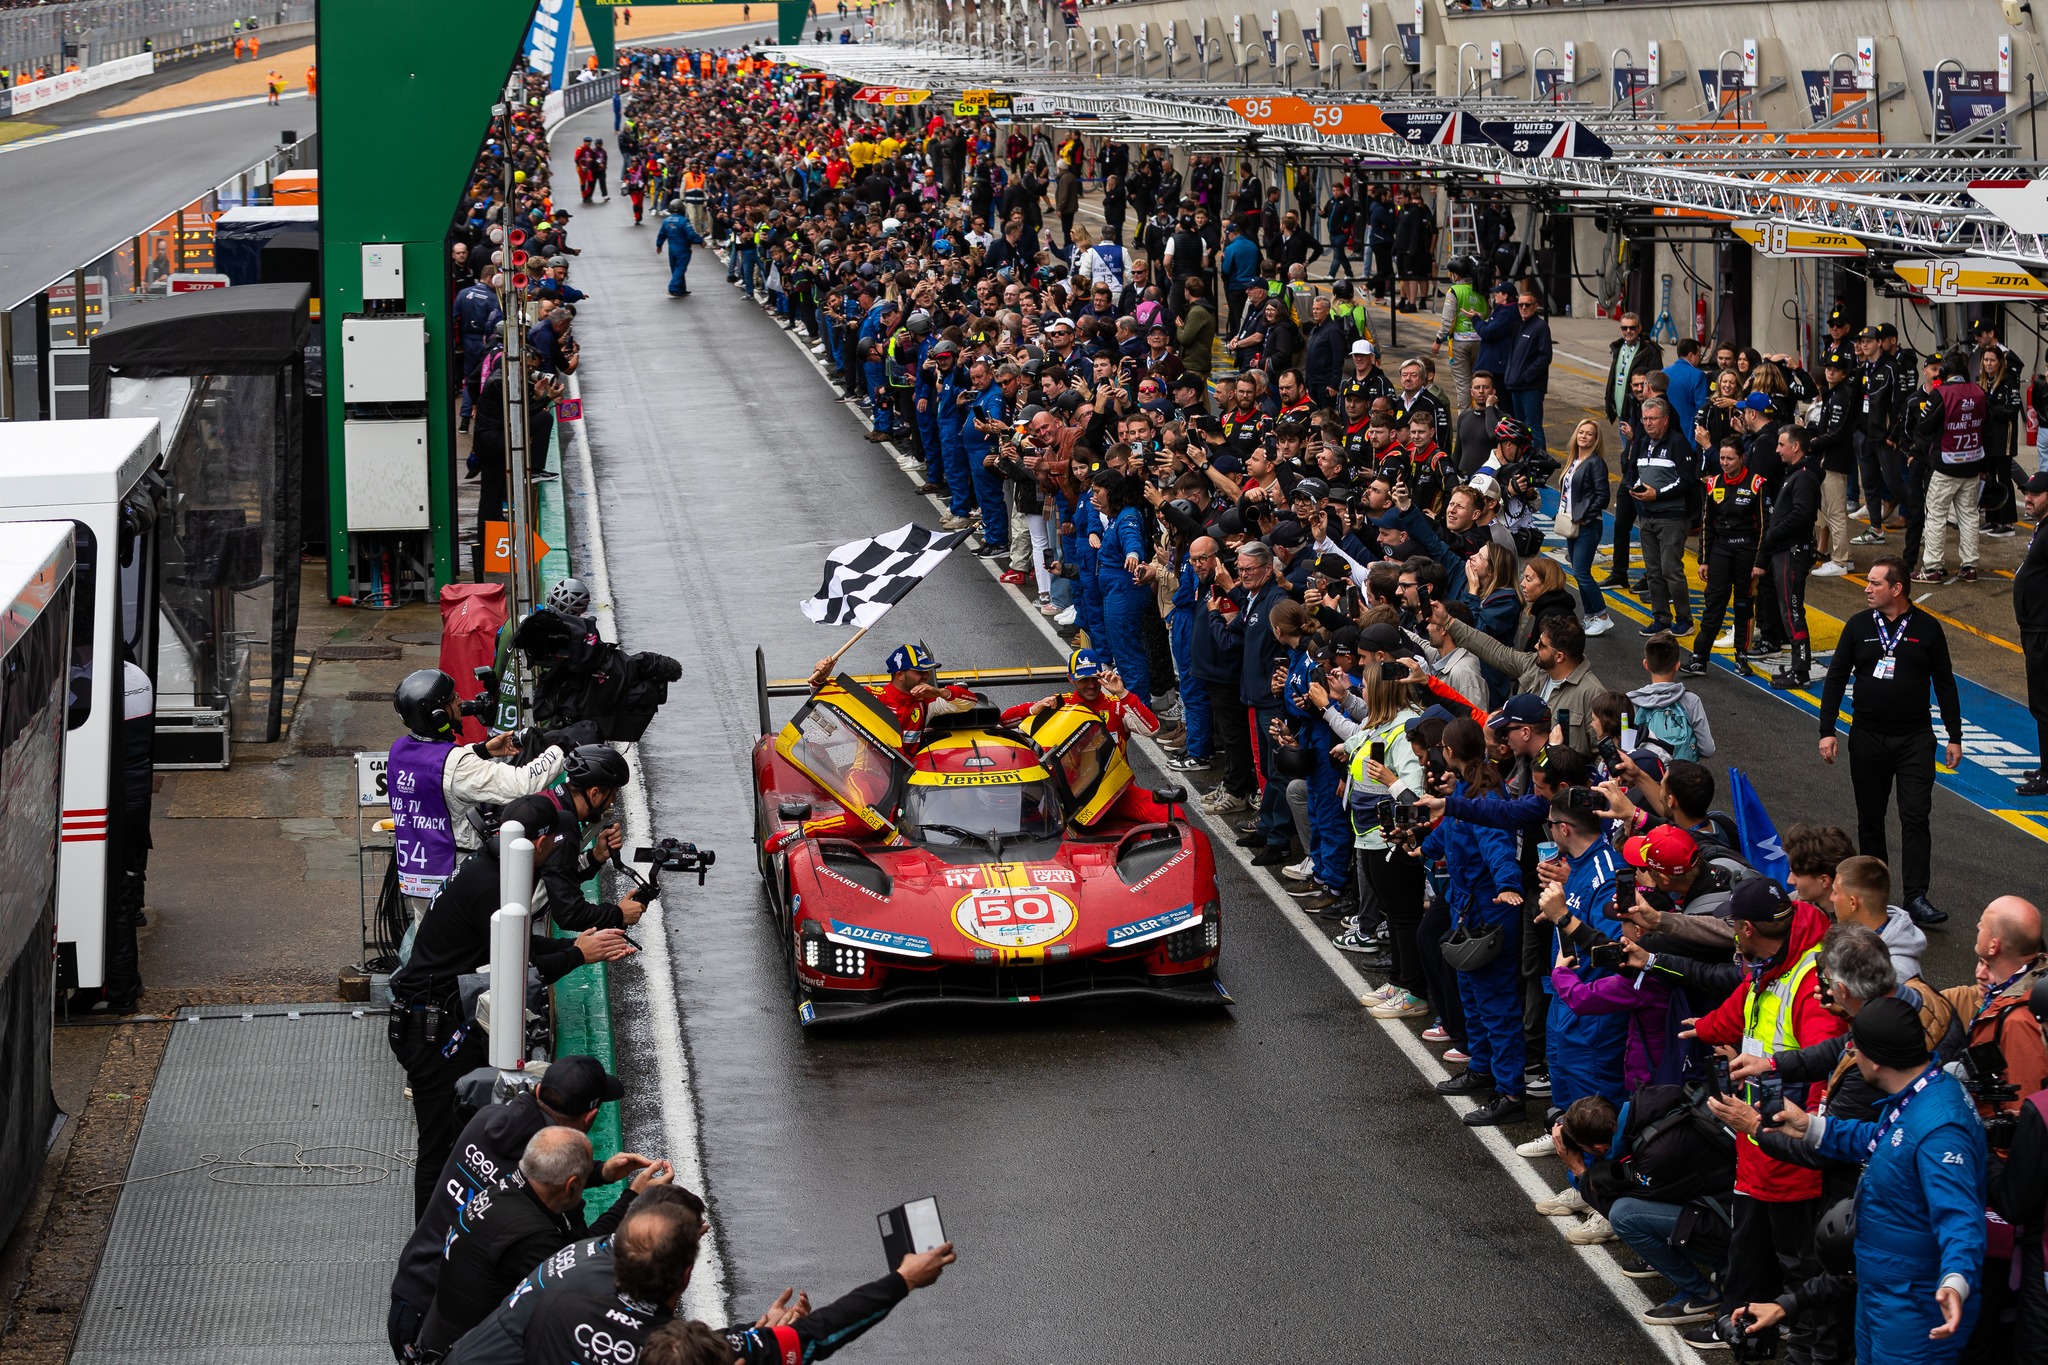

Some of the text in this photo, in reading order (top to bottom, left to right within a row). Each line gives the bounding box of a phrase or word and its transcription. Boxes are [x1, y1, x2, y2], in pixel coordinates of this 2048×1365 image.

[895, 94, 909, 102] 83
[1044, 101, 1054, 109] TF
[1016, 103, 1034, 112] #14
[1245, 100, 1272, 118] 95
[1312, 106, 1343, 127] 59
[1407, 113, 1443, 121] UNITED
[1407, 128, 1421, 140] 22
[1514, 122, 1554, 131] UNITED
[1513, 140, 1529, 152] 23
[1754, 222, 1789, 254] 38
[1810, 235, 1848, 245] JOTA
[1101, 275, 1112, 283] 13
[1921, 260, 1960, 296] 12
[1986, 275, 2030, 287] JOTA
[1944, 421, 1967, 430] ITLANE
[1953, 433, 1979, 450] 723
[124, 686, 151, 697] ORSCHE
[396, 770, 415, 787] 24h
[941, 770, 1023, 786] Ferrari
[408, 799, 421, 813] TV
[412, 815, 446, 831] TRACK
[1037, 874, 1073, 882] CAR
[1129, 849, 1193, 894] RICHARD MILLE
[815, 865, 892, 904] RICHARD MILLE
[945, 872, 976, 887] HY
[979, 897, 1049, 922] 50
[837, 926, 892, 944] ADLER
[1113, 920, 1161, 940] ADLER
[905, 941, 926, 949] GROUP
[465, 1143, 498, 1185] COOL
[1941, 1151, 1964, 1165] 24h
[465, 1158, 489, 1183] RACING
[606, 1308, 645, 1331] HRX
[573, 1323, 644, 1364] COO
